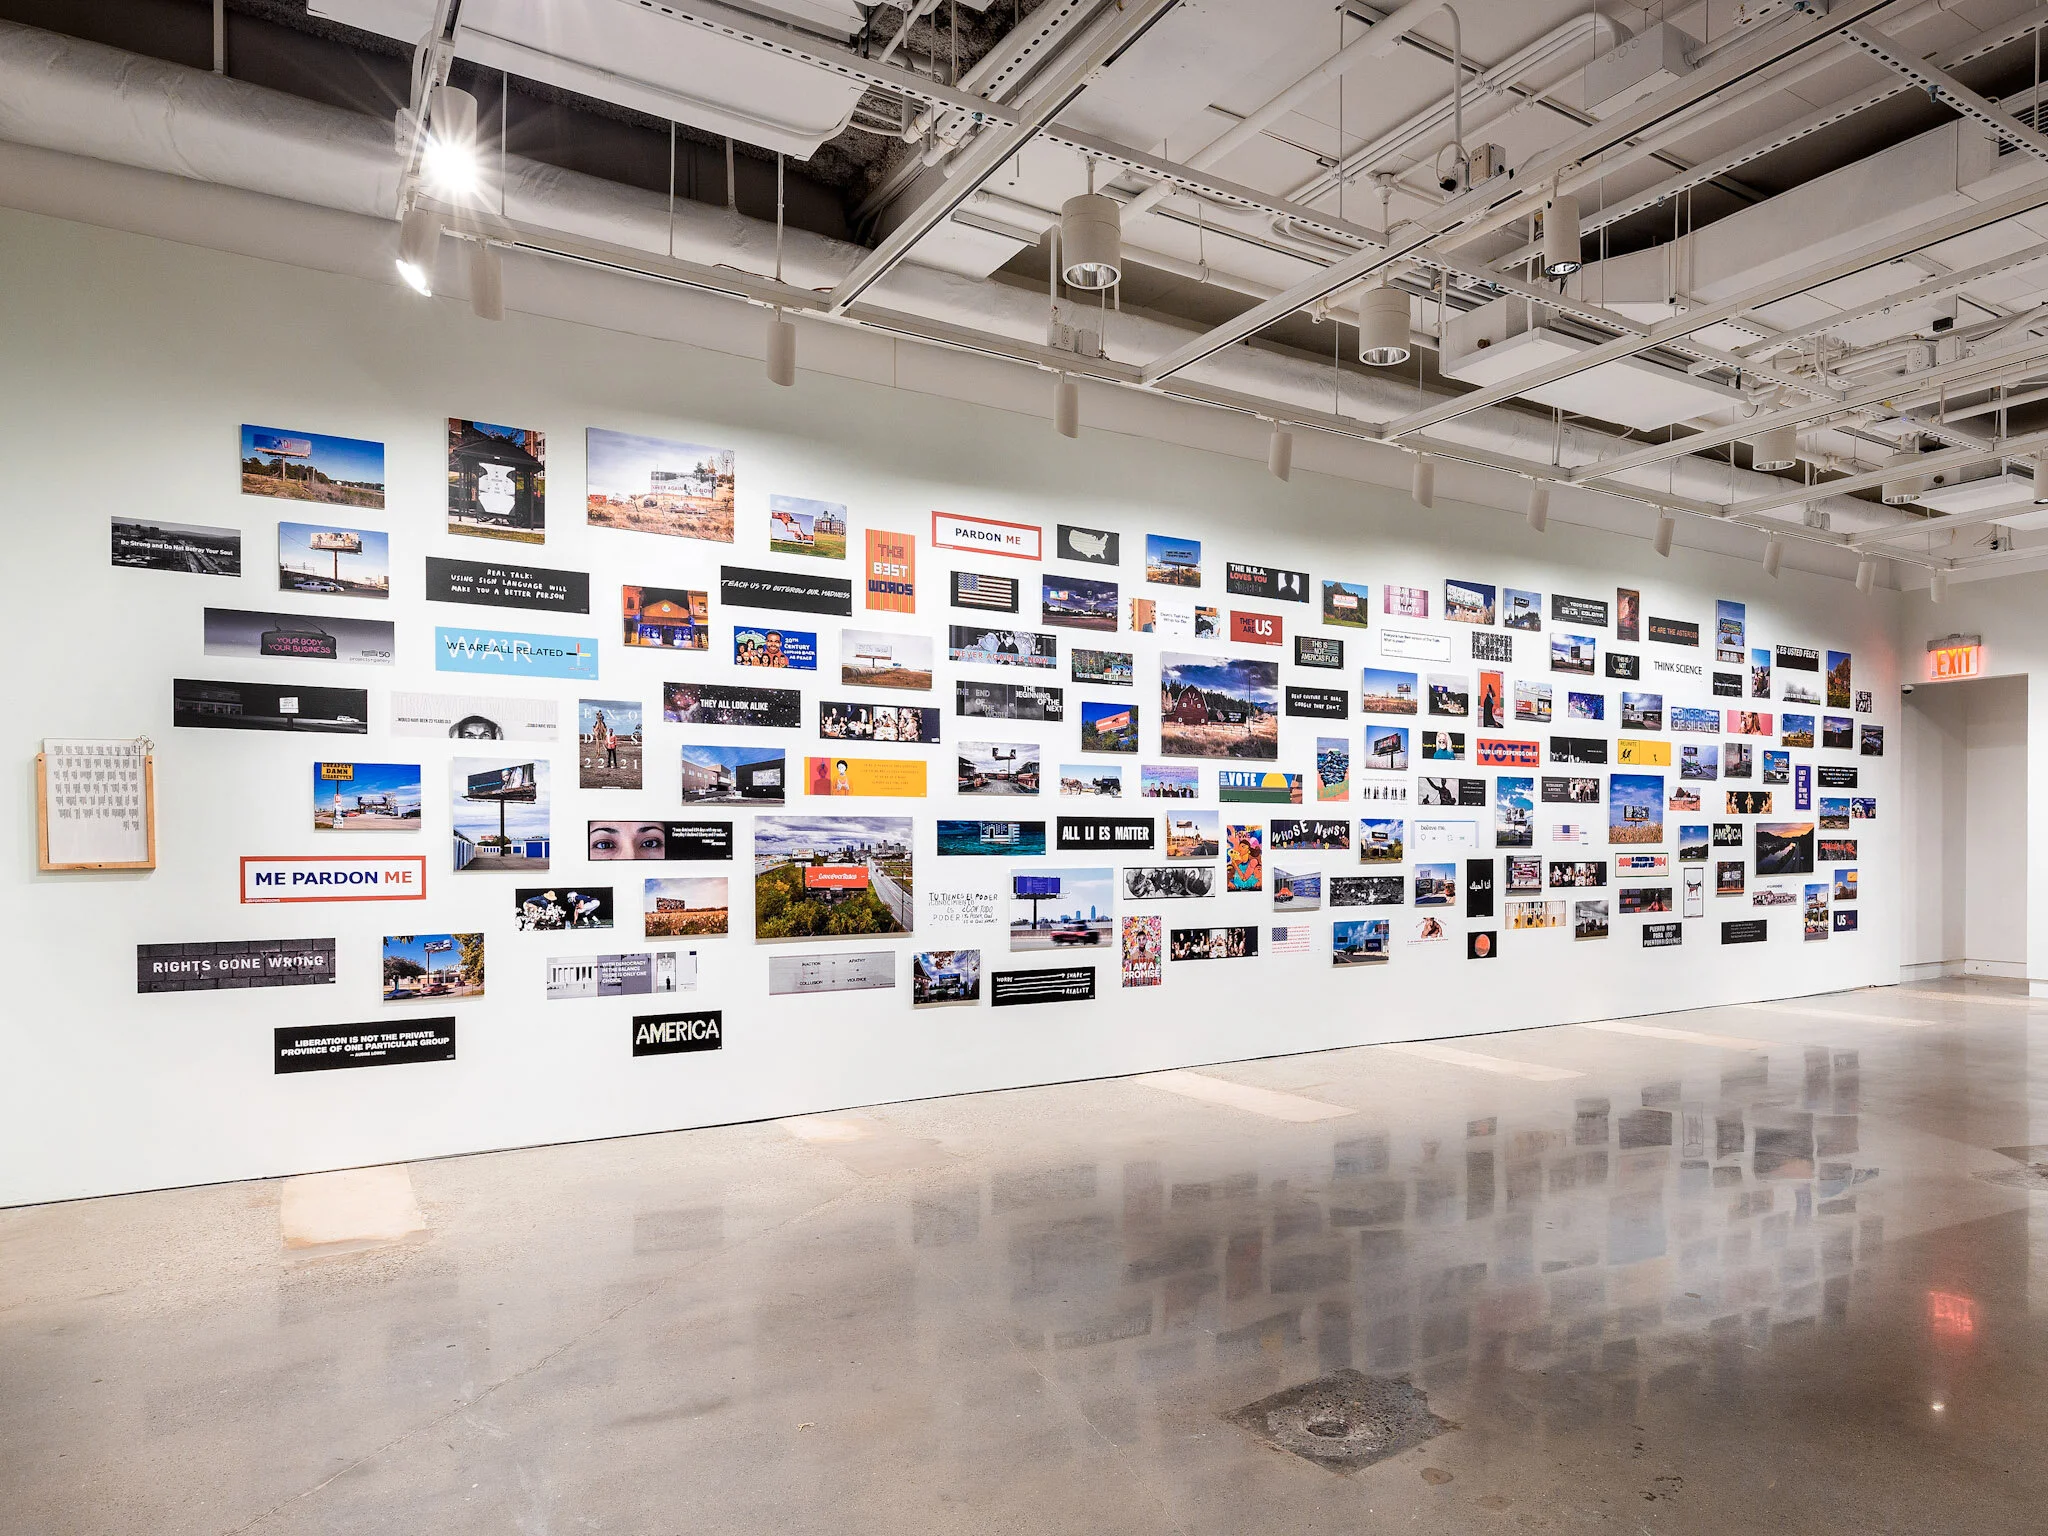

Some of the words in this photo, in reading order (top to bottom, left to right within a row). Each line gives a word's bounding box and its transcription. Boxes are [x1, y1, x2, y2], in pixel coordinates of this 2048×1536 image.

[955, 527, 1001, 542] PARDON
[1006, 535, 1020, 545] ME
[130, 540, 150, 549] Strong
[186, 545, 204, 554] Betray
[487, 569, 506, 577] REAL
[1231, 564, 1244, 572] THE
[1246, 565, 1267, 575] N.R.A.
[451, 574, 473, 582] USING
[479, 577, 497, 585] SIGN
[502, 579, 542, 590] LANGUAGE
[1230, 572, 1251, 581] LOVES
[1254, 575, 1267, 583] YOU
[505, 589, 531, 598] BETTER
[536, 592, 564, 600] PERSON
[721, 579, 748, 588] TEACH
[773, 586, 806, 594] OUTGROW
[821, 590, 850, 599] MADNESS
[1256, 619, 1272, 636] US
[1667, 628, 1675, 636] THE
[276, 637, 299, 646] YOUR
[301, 638, 323, 646] BODY
[268, 644, 291, 652] YOUR
[293, 645, 330, 654] BUSINESS
[447, 642, 465, 651] WE
[468, 642, 490, 652] ARE
[493, 645, 512, 654] ALL
[516, 647, 563, 657] RELATED
[1787, 647, 1802, 658] USTED
[954, 649, 983, 659] NEVER
[987, 652, 1015, 662] AGAIN
[1028, 656, 1048, 664] NOW
[1937, 647, 1972, 676] EXIT
[1654, 661, 1674, 672] THINK
[1676, 663, 1702, 675] SCIENCE
[976, 689, 990, 697] END
[1016, 691, 1050, 700] BEGINNING
[700, 699, 716, 708] THEY
[718, 701, 730, 709] ALL
[732, 701, 748, 710] LOOK
[750, 702, 768, 711] ALIKE
[1046, 705, 1063, 713] NEXT
[1673, 720, 1685, 729] OF
[1686, 721, 1718, 732] SILENCE
[1480, 742, 1537, 763] VOTE!
[1229, 773, 1256, 786] VOTE
[1063, 826, 1080, 840] ALL
[1115, 826, 1149, 841] MATTER
[1272, 820, 1309, 843] WHOSE
[1314, 821, 1346, 839] NEWS?
[256, 872, 285, 886] ME
[292, 872, 378, 885] PARDON
[384, 871, 412, 883] ME
[975, 893, 998, 901] PODER
[1837, 914, 1846, 926] US
[153, 960, 211, 973] RIGHTS
[219, 958, 260, 970] GONE
[268, 956, 324, 968] WRONG
[1133, 962, 1147, 971] AM
[1123, 969, 1160, 979] PROMISE
[636, 1019, 719, 1045] AMERICA
[295, 1037, 347, 1047] LIBERATION
[349, 1036, 358, 1044] IS
[360, 1035, 378, 1043] NOT
[399, 1031, 434, 1040] PRIVATE
[281, 1046, 328, 1057] PROVINCE
[330, 1044, 342, 1053] OF
[344, 1043, 363, 1052] ONE
[365, 1040, 418, 1050] PARTICULAR
[420, 1037, 451, 1047] GROUP
